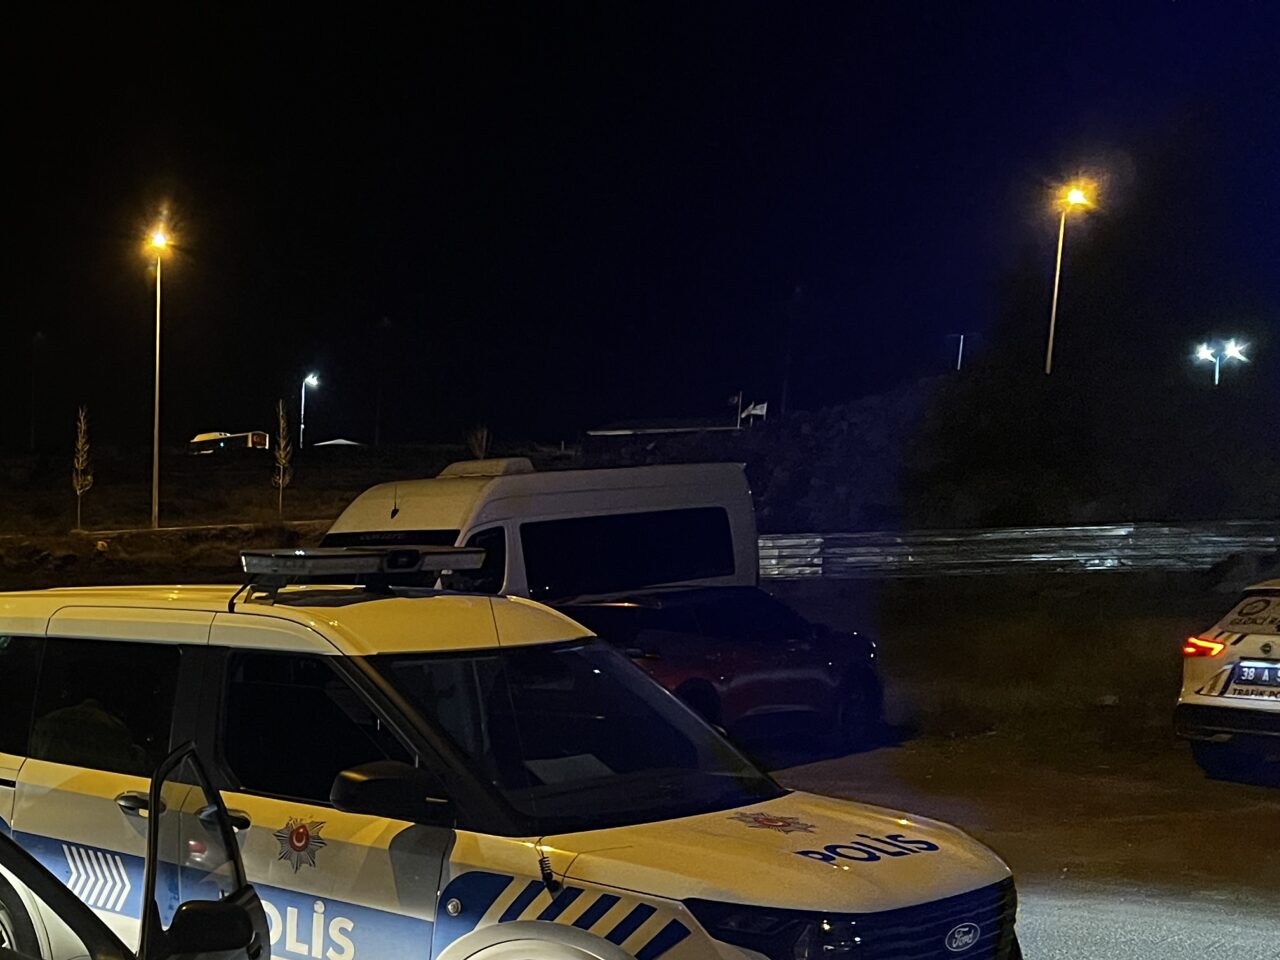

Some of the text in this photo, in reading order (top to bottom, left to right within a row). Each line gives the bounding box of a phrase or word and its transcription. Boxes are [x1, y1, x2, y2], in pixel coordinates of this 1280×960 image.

[1241, 668, 1255, 680] 38
[1262, 668, 1270, 681] A
[793, 833, 940, 868] POLİS
[951, 926, 975, 948] Ford
